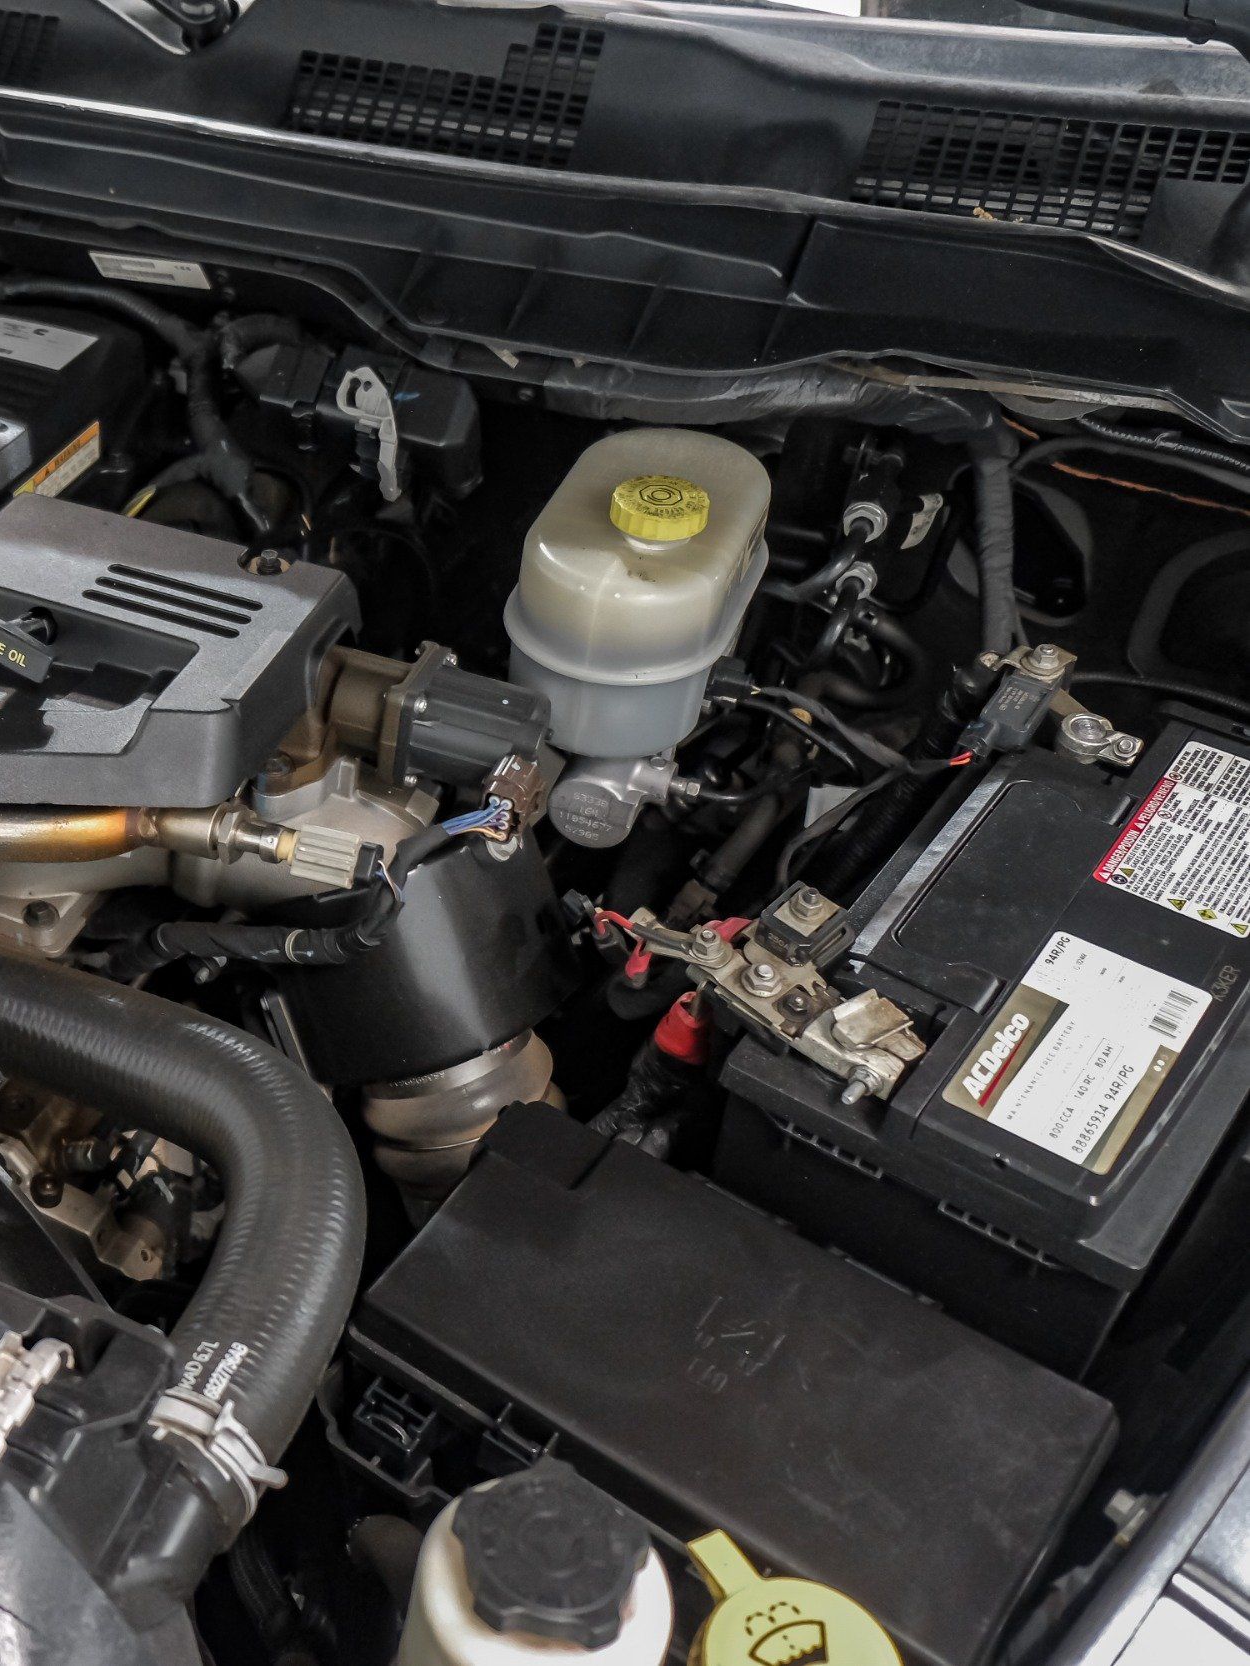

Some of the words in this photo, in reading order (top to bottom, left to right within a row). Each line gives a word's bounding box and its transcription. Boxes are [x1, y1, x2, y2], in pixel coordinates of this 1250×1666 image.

[7, 648, 28, 668] OIL
[1044, 936, 1071, 967] 94R/PG
[961, 1013, 1030, 1100] ACDelco
[1047, 1121, 1065, 1139] 800
[1058, 1105, 1075, 1123] CCA
[1073, 1084, 1088, 1100] 140
[1082, 1073, 1095, 1085] RC
[1093, 1056, 1107, 1068] 80
[1100, 1044, 1114, 1057] AH
[1071, 1104, 1110, 1154] 88865934
[1105, 1064, 1135, 1102] 94R/PG
